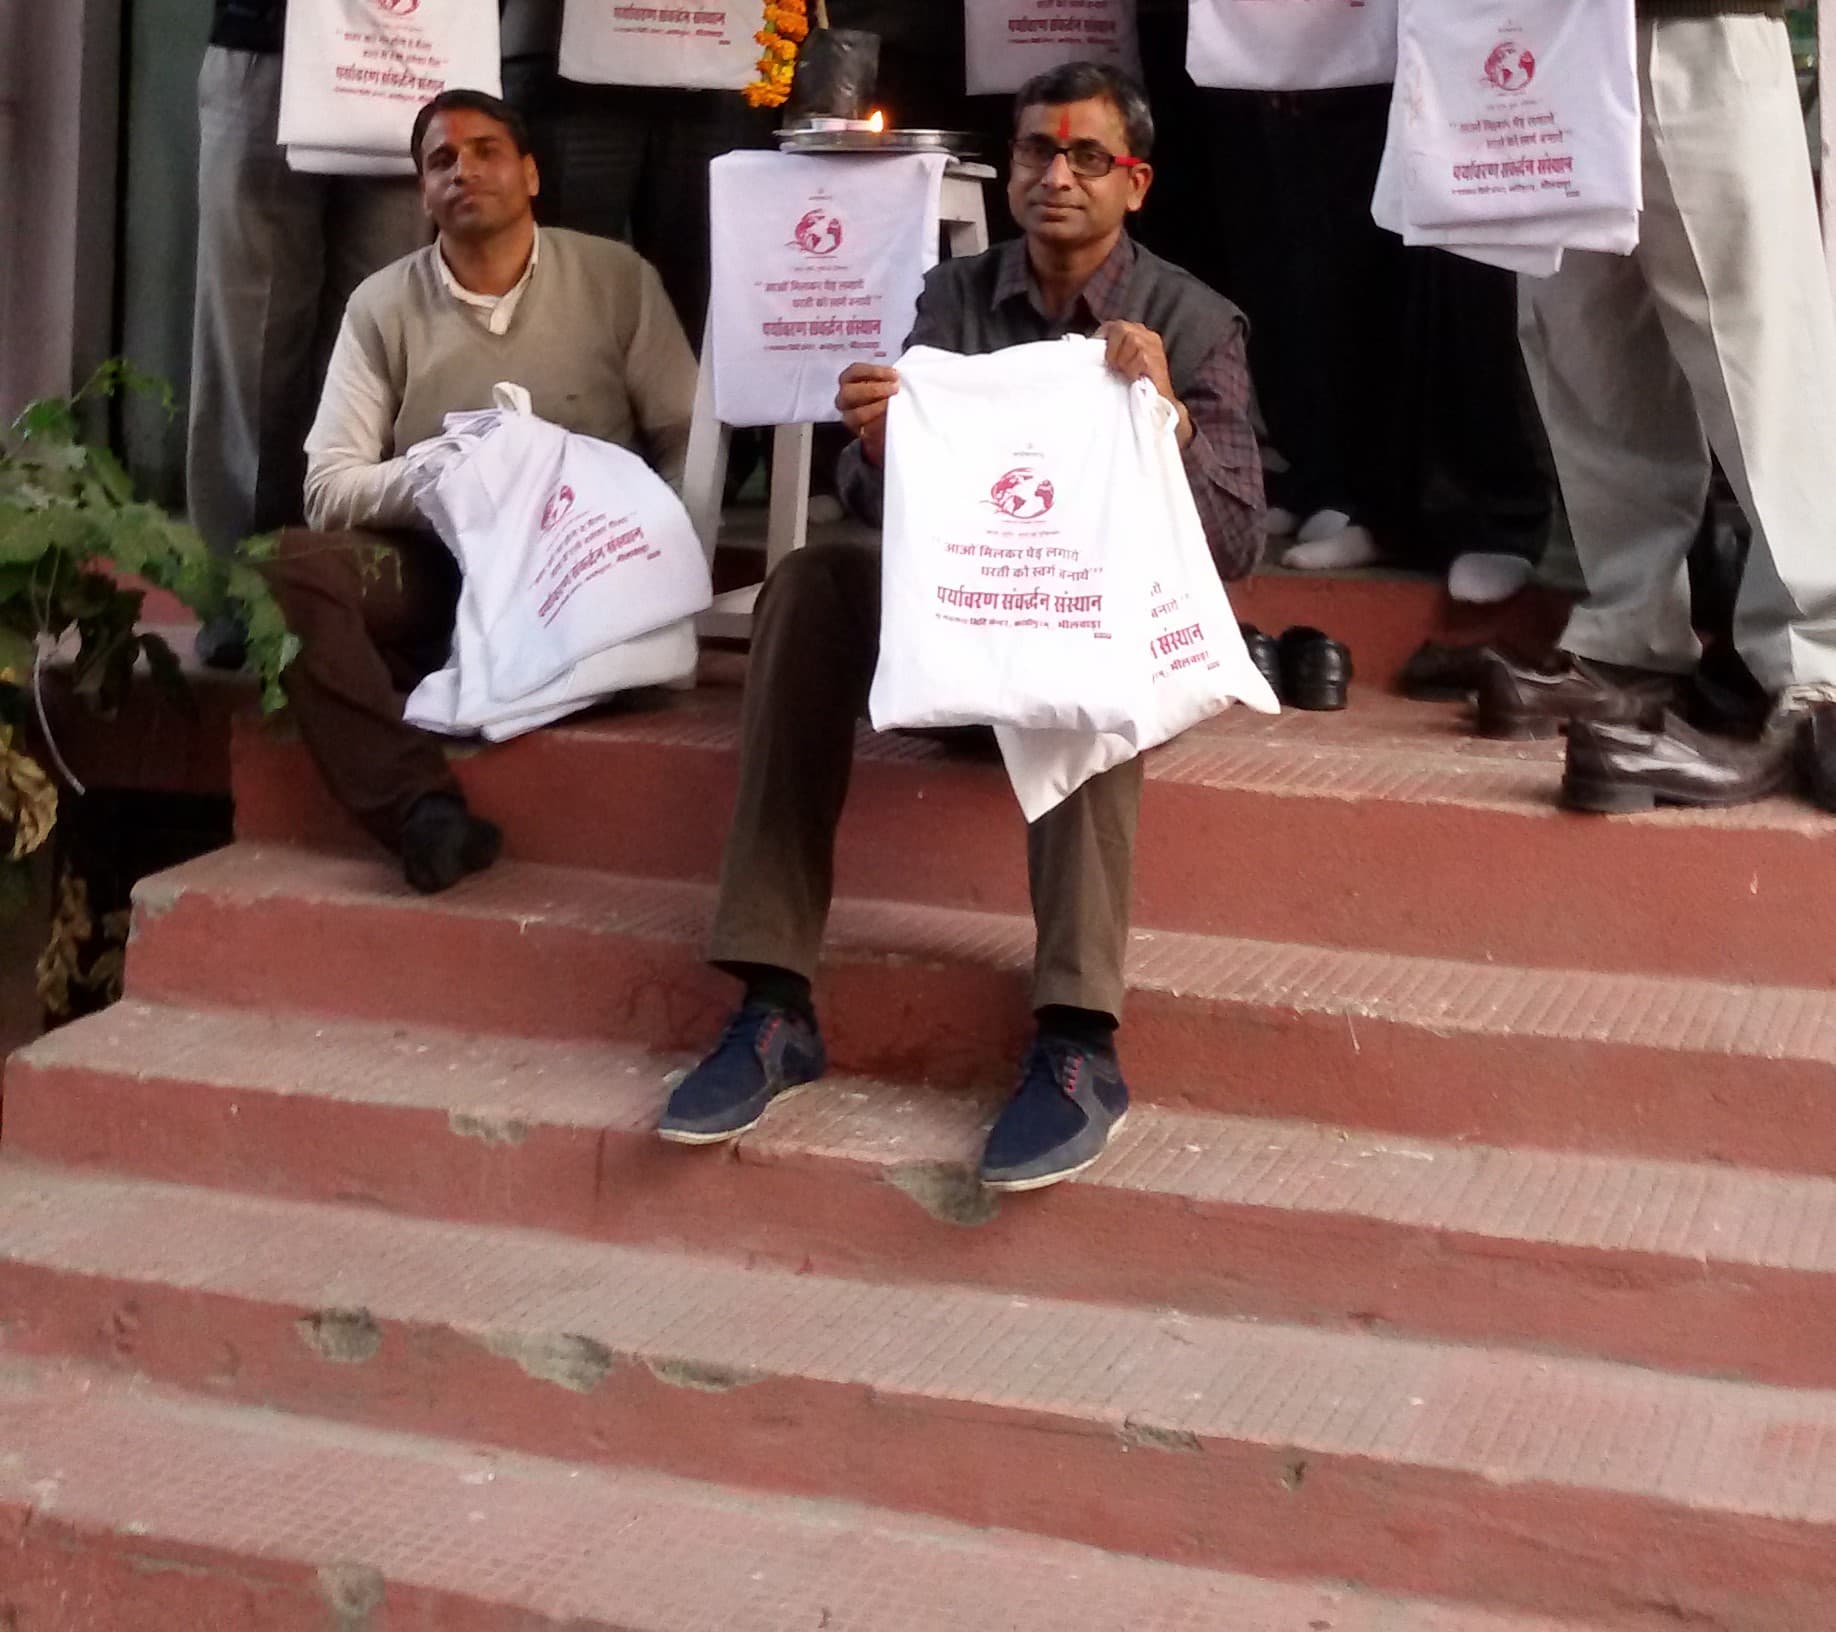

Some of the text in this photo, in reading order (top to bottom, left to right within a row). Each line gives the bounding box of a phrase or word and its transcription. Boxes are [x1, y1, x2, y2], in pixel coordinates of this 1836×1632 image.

[936, 584, 999, 610] पर्यावरण
[1053, 590, 1103, 613] संस्थान
[1156, 622, 1205, 656] संस्थान
